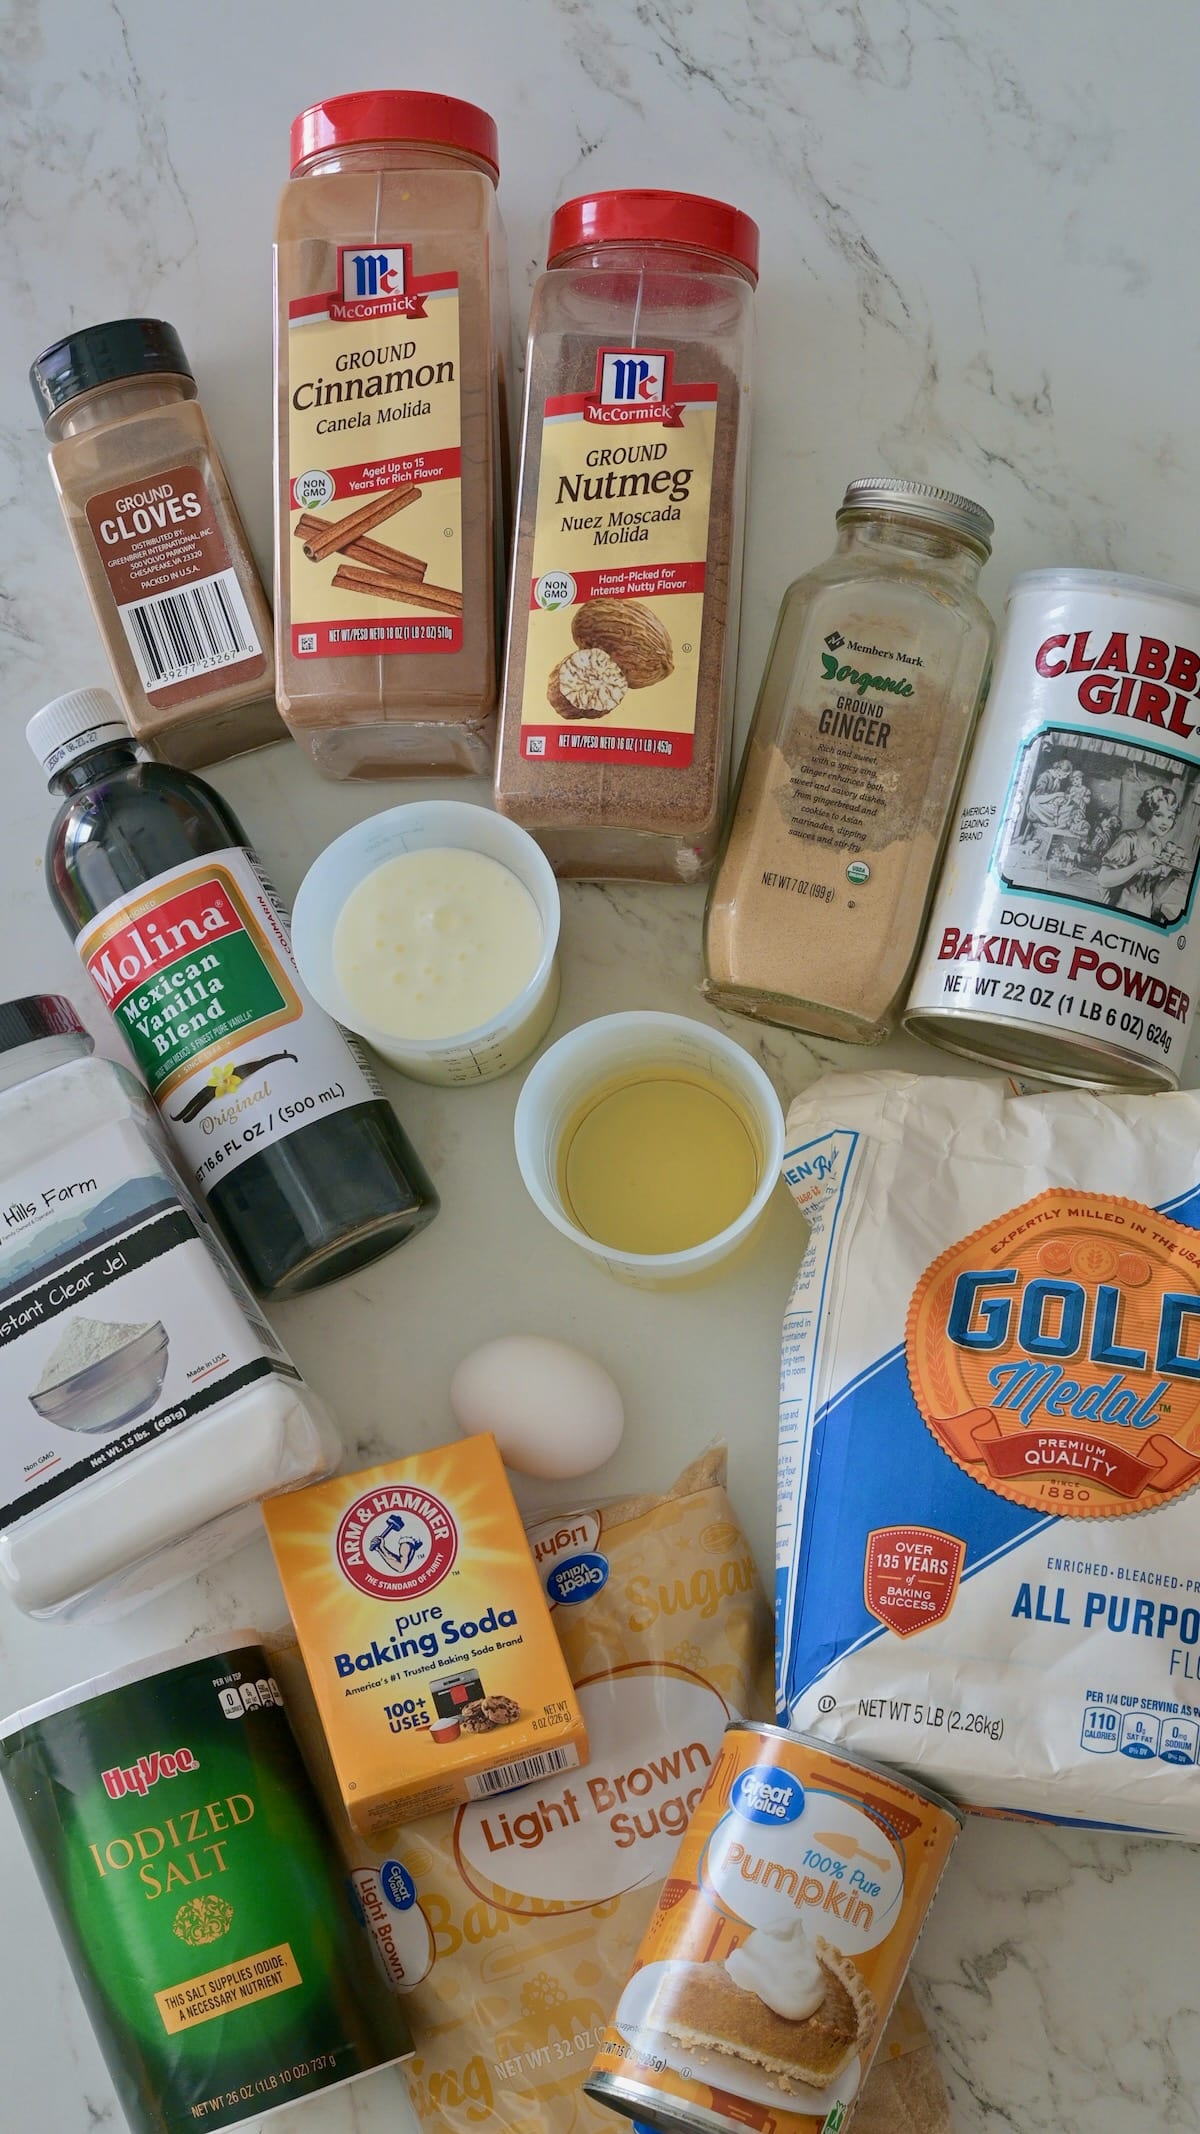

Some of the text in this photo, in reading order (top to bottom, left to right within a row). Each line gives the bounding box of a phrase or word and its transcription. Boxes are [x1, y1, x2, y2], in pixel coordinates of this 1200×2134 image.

[332, 299, 415, 318] McCormick
[336, 341, 416, 371] GROUND
[292, 360, 455, 411] Cinnamon
[316, 400, 431, 435] Canela Molida
[587, 404, 671, 422] McCormick
[363, 457, 425, 478] Aged Up to 15
[586, 443, 668, 467] GROUND
[303, 478, 326, 488] NON
[303, 487, 327, 497] GMO
[349, 467, 443, 491] Years for Rich Flavor
[555, 468, 694, 504] Nutmeg
[115, 484, 173, 513] GROUND
[100, 492, 202, 545] CLOVES
[561, 505, 681, 531] Nuez Moscada
[593, 526, 649, 545] Molida
[141, 565, 200, 589] PACKED IN U.S.A.
[545, 581, 568, 590] NON
[590, 580, 687, 596] Intense Nutty Flavor
[599, 569, 676, 584] Hand-Picked for
[544, 589, 568, 598] GMO
[847, 640, 924, 667] Member's Mark
[1035, 631, 1200, 692] CLABB
[837, 665, 915, 697] organic
[836, 696, 884, 718] GROUND
[1078, 674, 1196, 739] GIRL
[818, 709, 891, 749] GINGER
[800, 765, 884, 792] Ginger enhances both
[791, 789, 877, 817] from gingerbread and
[960, 805, 997, 817] AMERICA'S
[959, 831, 983, 842] BRAND
[960, 819, 989, 829] LEADING
[1000, 910, 1160, 964] DOUBLE ACTING
[91, 905, 230, 1007] Molina
[123, 953, 221, 1024] Mexican
[937, 927, 1190, 1024] BAKING POWDER
[135, 976, 224, 1038] Vanilla
[944, 974, 1173, 1054] NET WT 22 OZ (1 LB 6 OZ) 624g
[152, 997, 225, 1056] Blend
[200, 1080, 273, 1136] Original
[3, 1178, 97, 1227] Hills Farm
[990, 1209, 1061, 1254] EXPERTLY
[1067, 1208, 1125, 1224] MILLED
[1131, 1222, 1147, 1234] IN
[1151, 1231, 1177, 1253] THE
[0, 1252, 128, 1337] stant Clear Jel
[186, 1352, 227, 1379] Made in USA
[987, 1360, 1172, 1429] Medal
[1038, 1438, 1106, 1456] PREMIUM
[24, 1450, 55, 1473] Non GMO
[1025, 1450, 1118, 1478] QUALITY
[1040, 1484, 1090, 1501] 1880
[1051, 1479, 1081, 1488] SINCE
[344, 1492, 450, 1566] ARM & HAMMER
[535, 1525, 588, 1562] Light
[895, 1542, 933, 1556] OVER
[556, 1563, 590, 1583] Value
[876, 1554, 949, 1576] 135 YEARS
[561, 1567, 603, 1597] Great
[887, 1586, 931, 1600] BAKING
[905, 1574, 916, 1586] of
[879, 1596, 936, 1612] SUCCESS
[1011, 1582, 1070, 1625] ALL
[396, 1606, 443, 1636] pure
[334, 1607, 518, 1678] Baking Soda
[345, 1635, 524, 1697] America's #1 Trusted Baking Soda Brand
[384, 1698, 426, 1720] 100+
[544, 1701, 568, 1715] NET WT
[1086, 1690, 1192, 1716] PER 1/4 CUP SERVING AS
[389, 1711, 430, 1734] USES
[858, 1699, 1004, 1741] NET WT 5 LB (2.26kg)
[1090, 1712, 1116, 1730] 110
[1084, 1730, 1116, 1742] CALORIES
[480, 1798, 581, 1852] Light
[586, 1742, 712, 1814] Brown
[741, 1775, 793, 1806] Great
[747, 1795, 786, 1818] Value
[88, 1794, 255, 1878] IODIZED
[139, 1841, 229, 1900] SALT
[391, 1865, 411, 1901] Great
[802, 1849, 882, 1897] 100% Pure
[388, 1876, 401, 1903] Value
[721, 1841, 875, 1932] Pumpkin
[360, 1878, 405, 1980] Light Brown
[165, 1955, 288, 2010] THIS SALT SUPPLIES IODIDE,
[179, 1971, 284, 2021] A NECESSARY NUTRIENT
